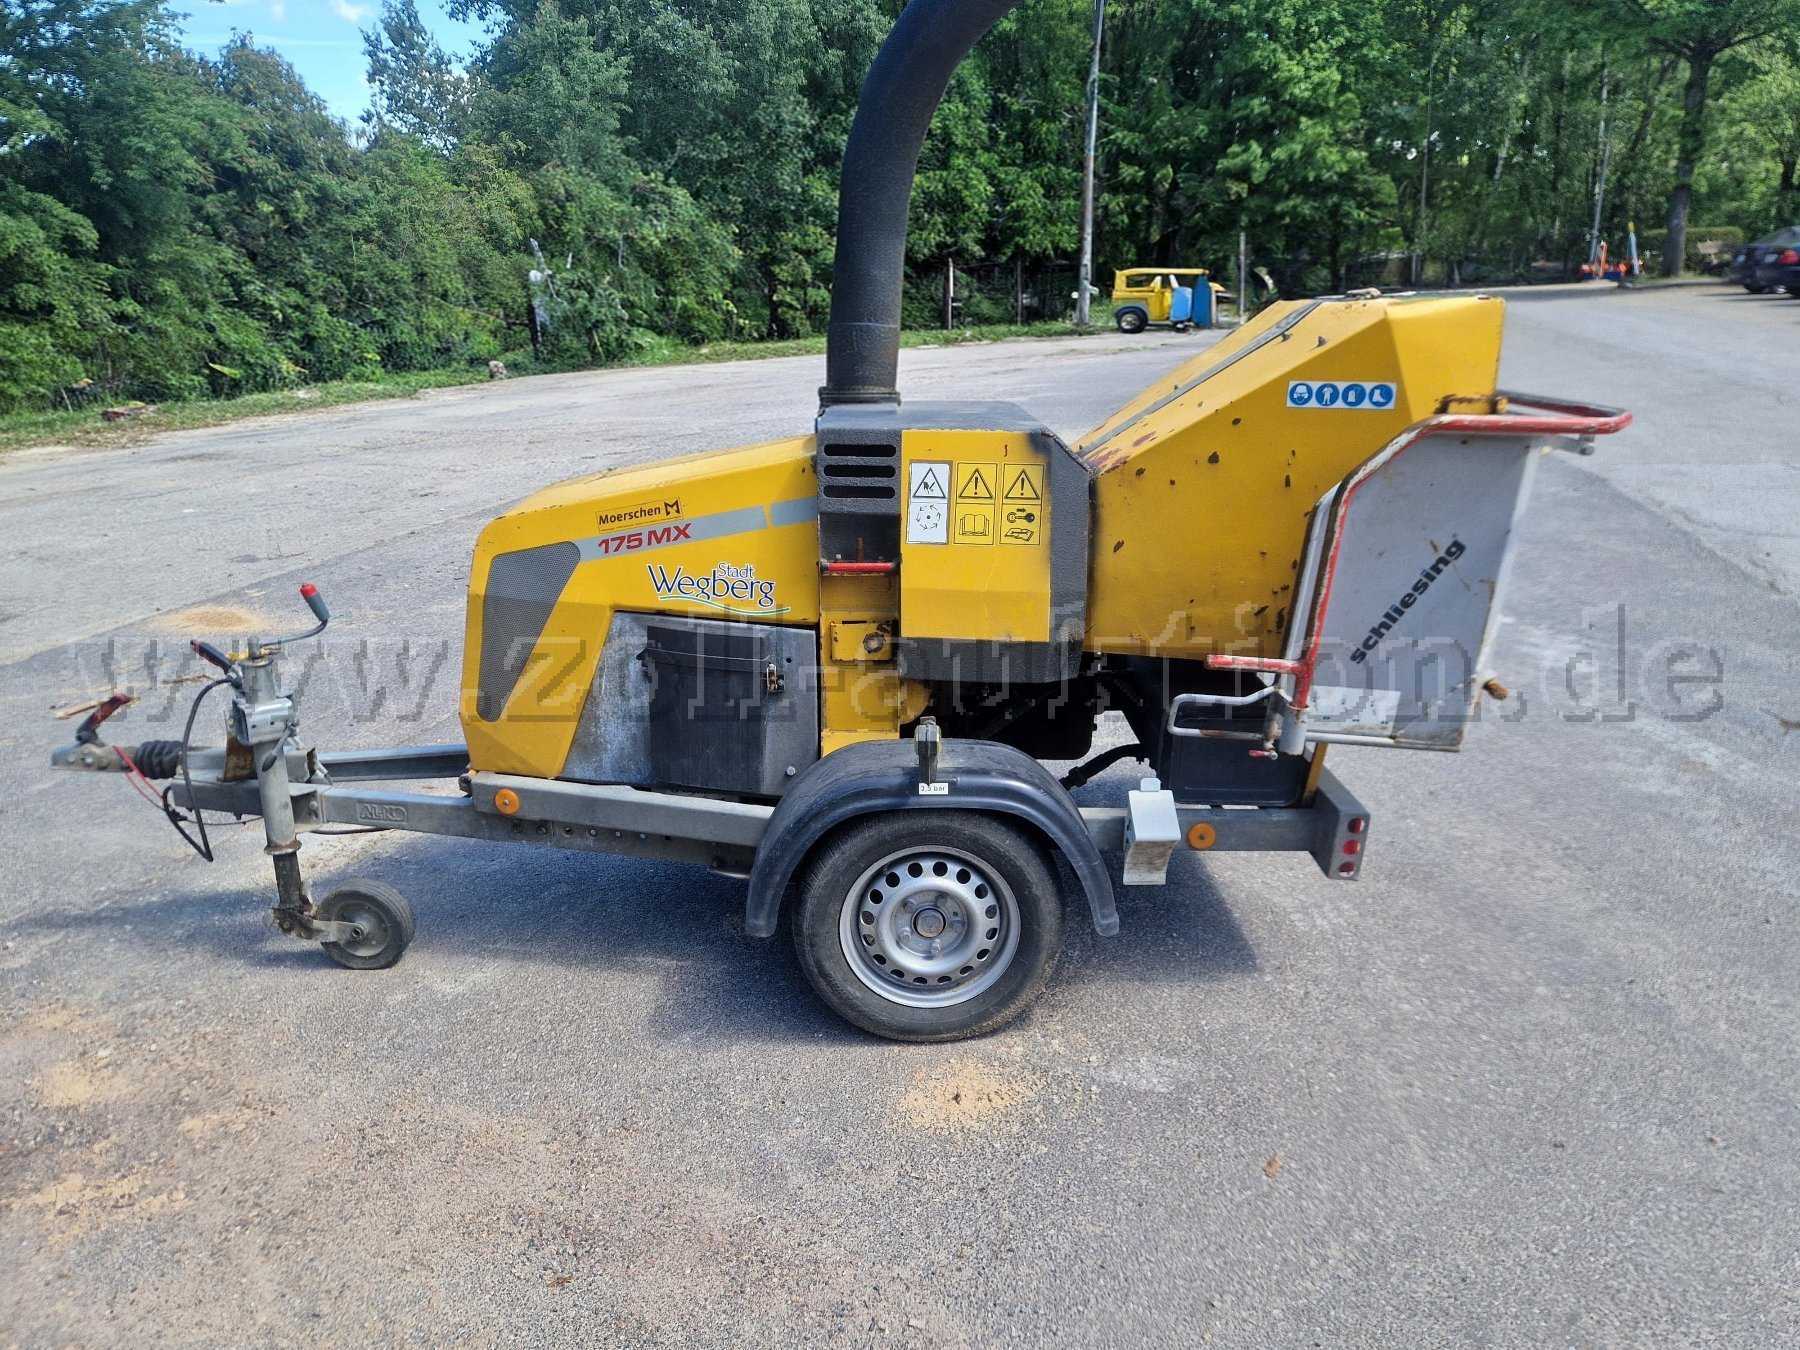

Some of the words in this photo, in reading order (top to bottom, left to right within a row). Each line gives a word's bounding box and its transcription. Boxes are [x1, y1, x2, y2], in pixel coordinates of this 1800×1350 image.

[598, 506, 661, 525] Moerschen
[598, 532, 643, 554] 175
[646, 523, 693, 546] MX
[646, 564, 775, 608] Wegberg
[717, 562, 754, 579] Stadt
[1350, 539, 1466, 664] schliesing
